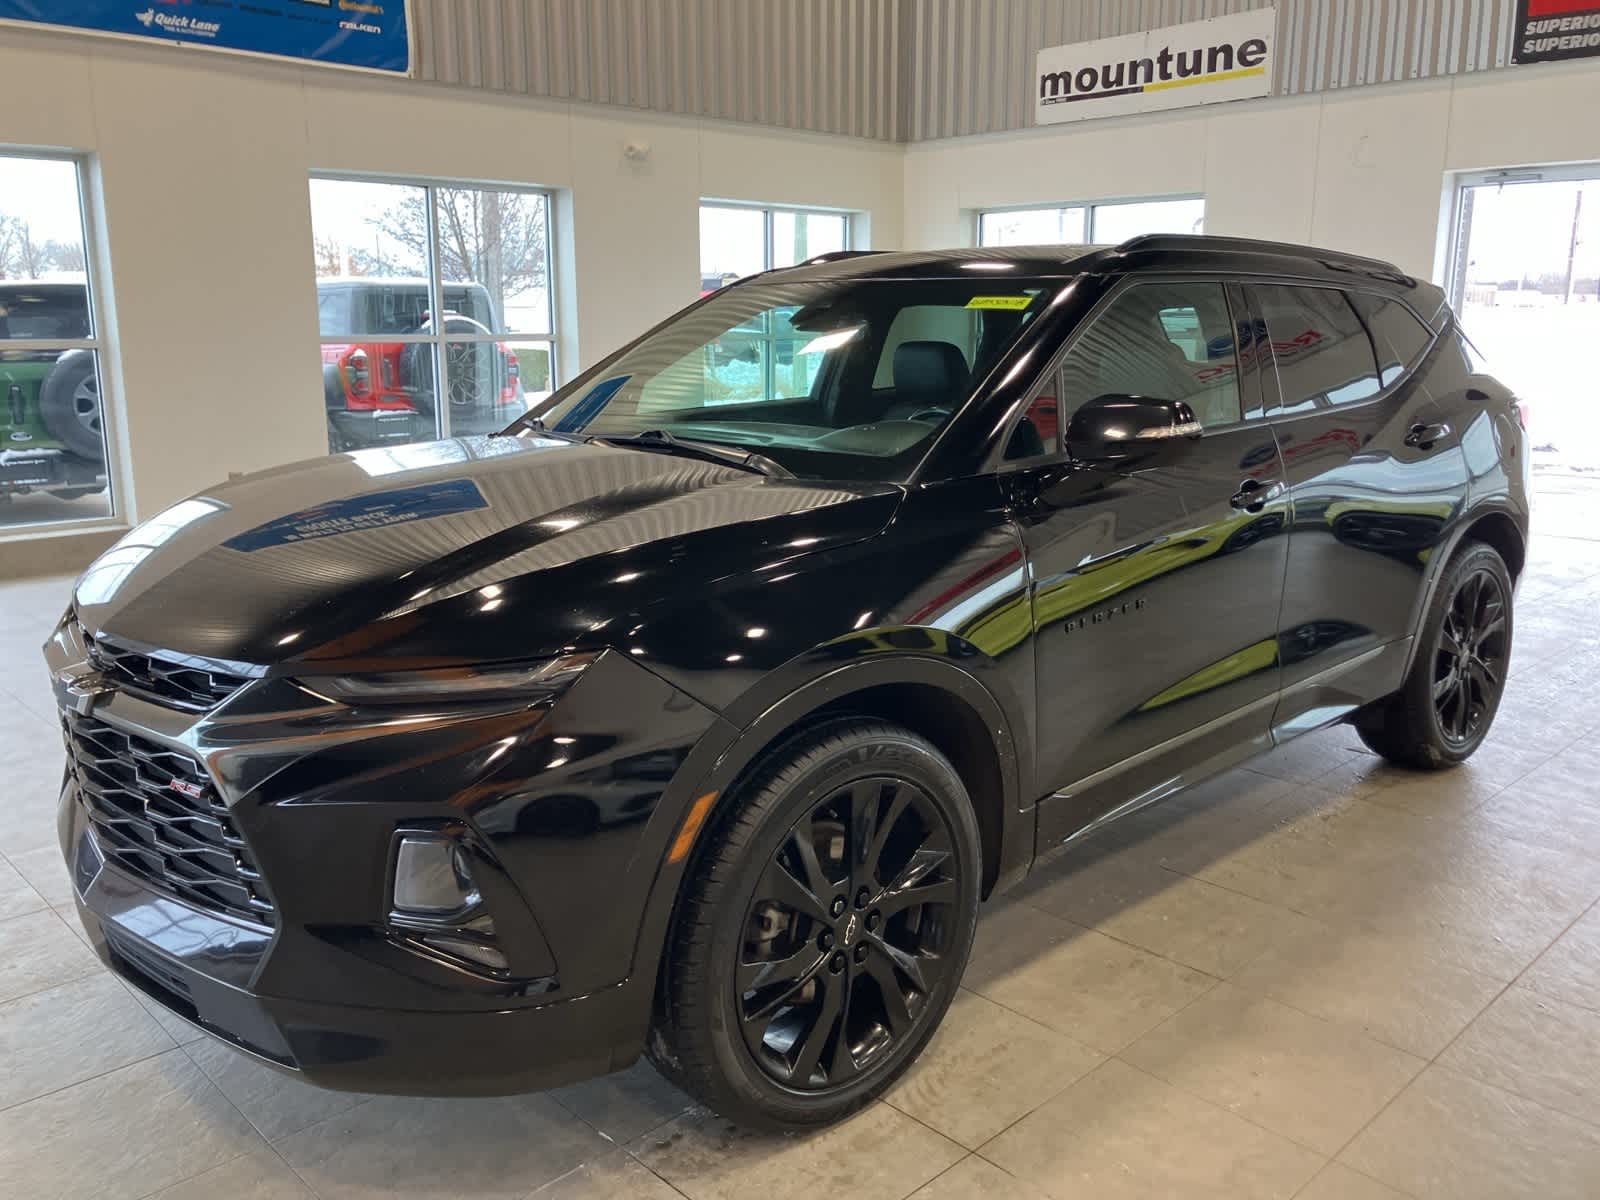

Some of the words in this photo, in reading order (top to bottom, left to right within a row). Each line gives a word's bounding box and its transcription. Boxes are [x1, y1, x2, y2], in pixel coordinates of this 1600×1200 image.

[155, 12, 189, 27] Quick
[190, 18, 221, 32] Lane
[1040, 38, 1268, 98] mountune
[170, 779, 201, 799] RS
